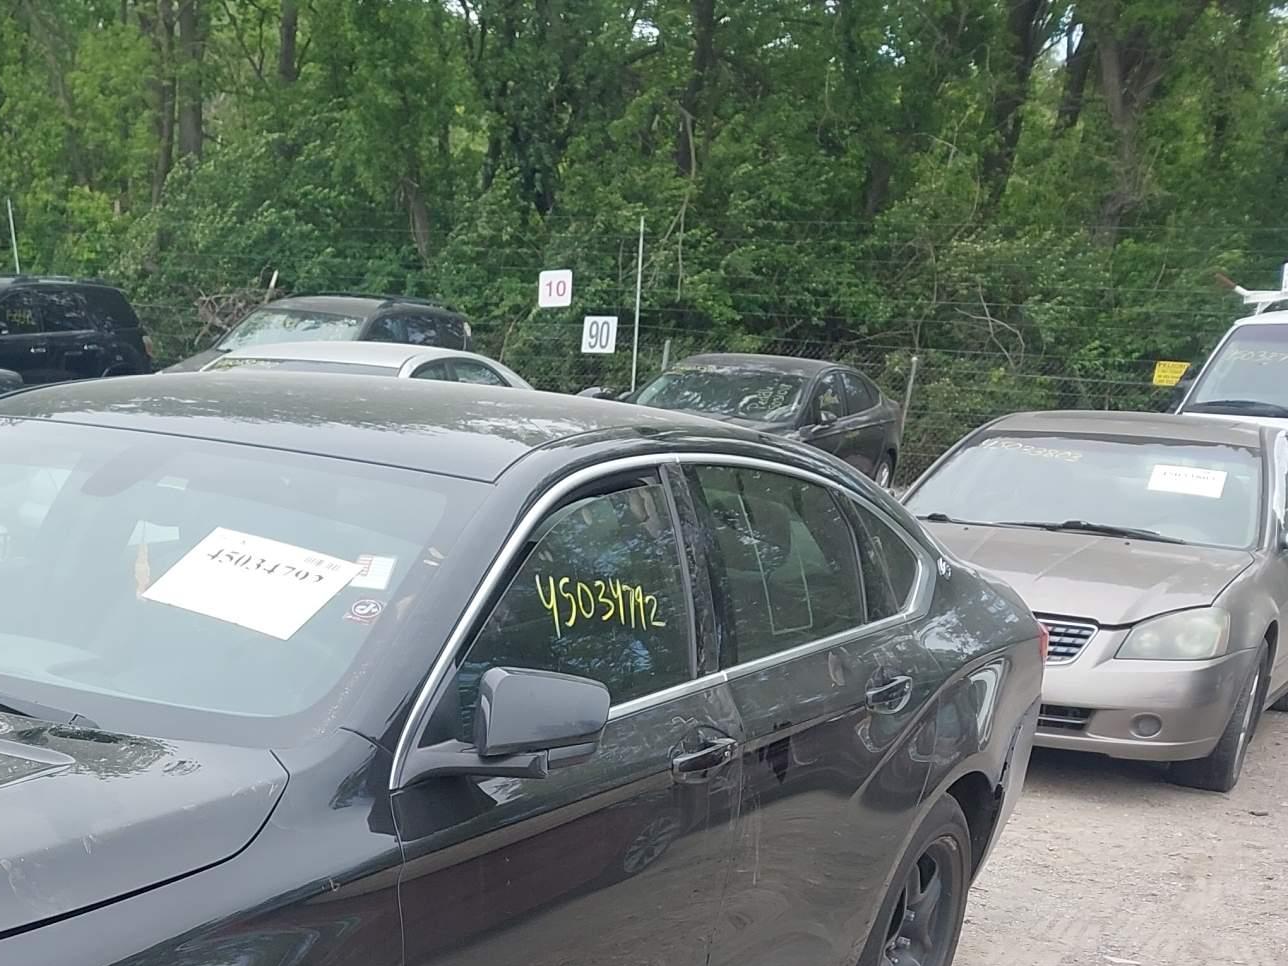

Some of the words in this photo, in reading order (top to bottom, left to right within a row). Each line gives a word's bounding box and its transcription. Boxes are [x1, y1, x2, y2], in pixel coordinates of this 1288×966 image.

[545, 280, 567, 297] 10
[588, 320, 610, 349] 90
[535, 574, 666, 639] 45034792
